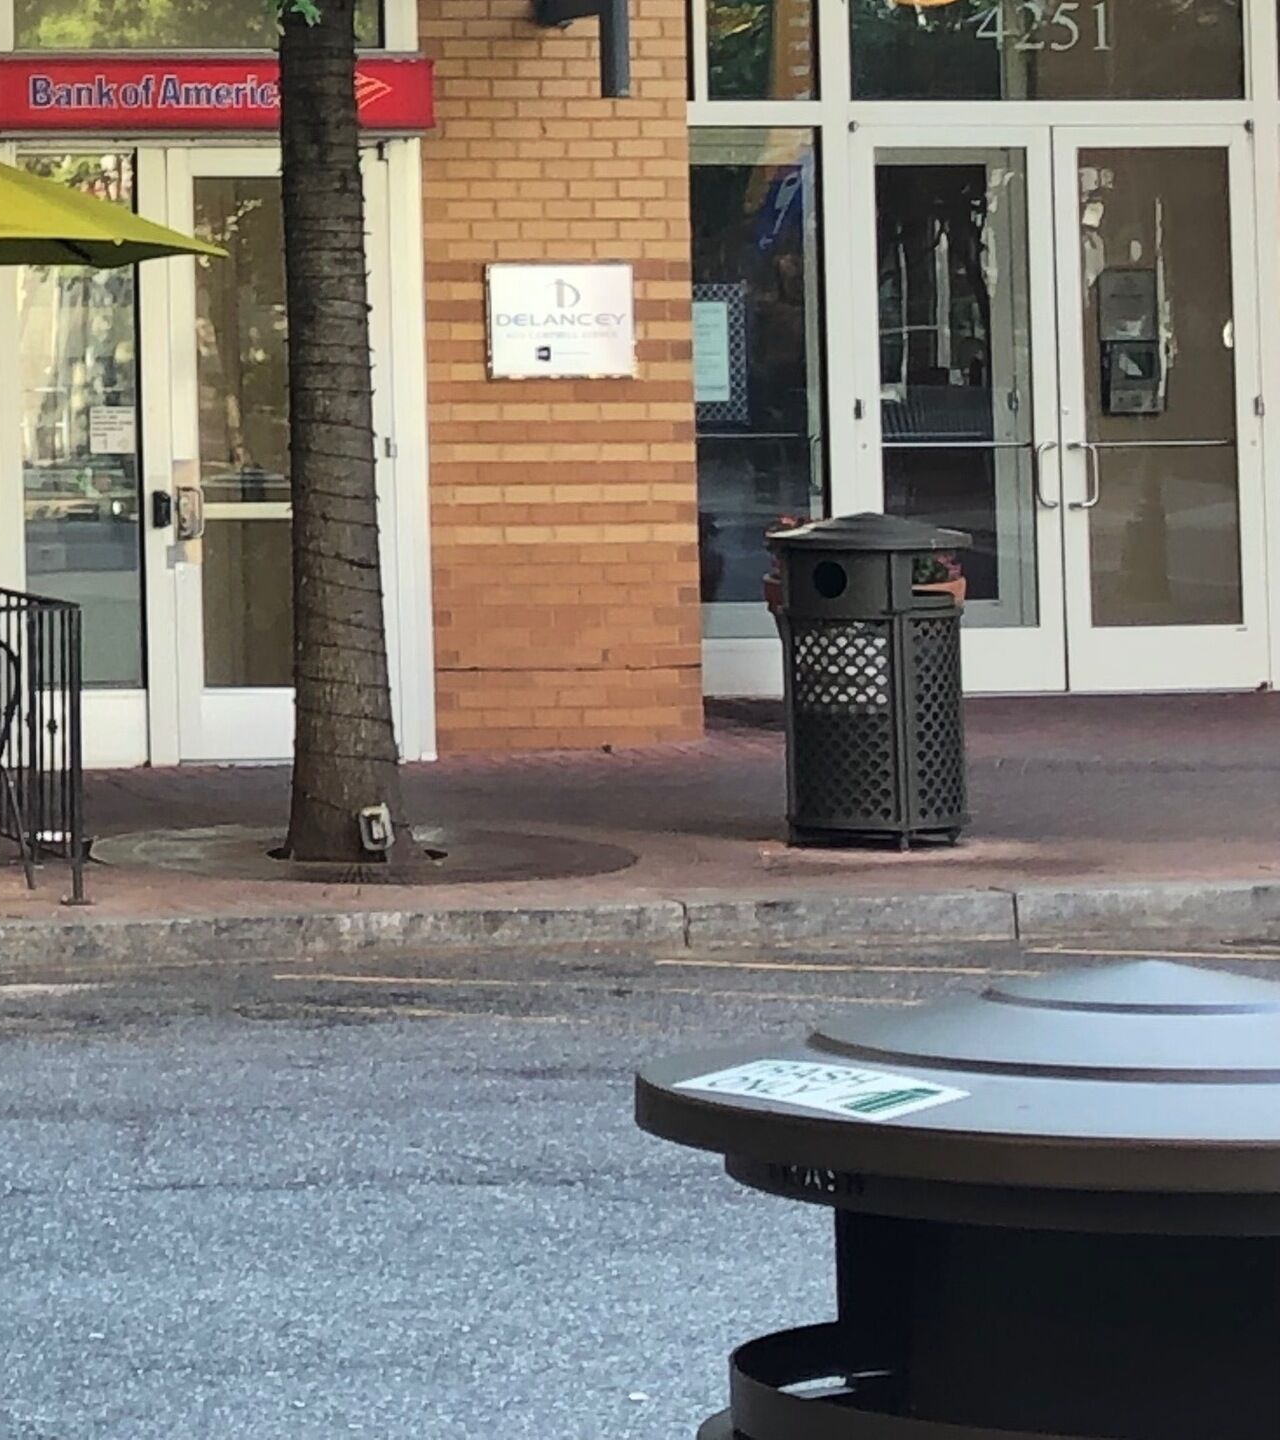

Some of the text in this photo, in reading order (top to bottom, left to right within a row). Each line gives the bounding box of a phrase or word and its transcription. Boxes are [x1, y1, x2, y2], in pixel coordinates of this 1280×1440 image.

[975, 1, 1112, 51] 4251
[29, 74, 281, 109] Bank of Americ
[495, 313, 627, 327] DELANCEY
